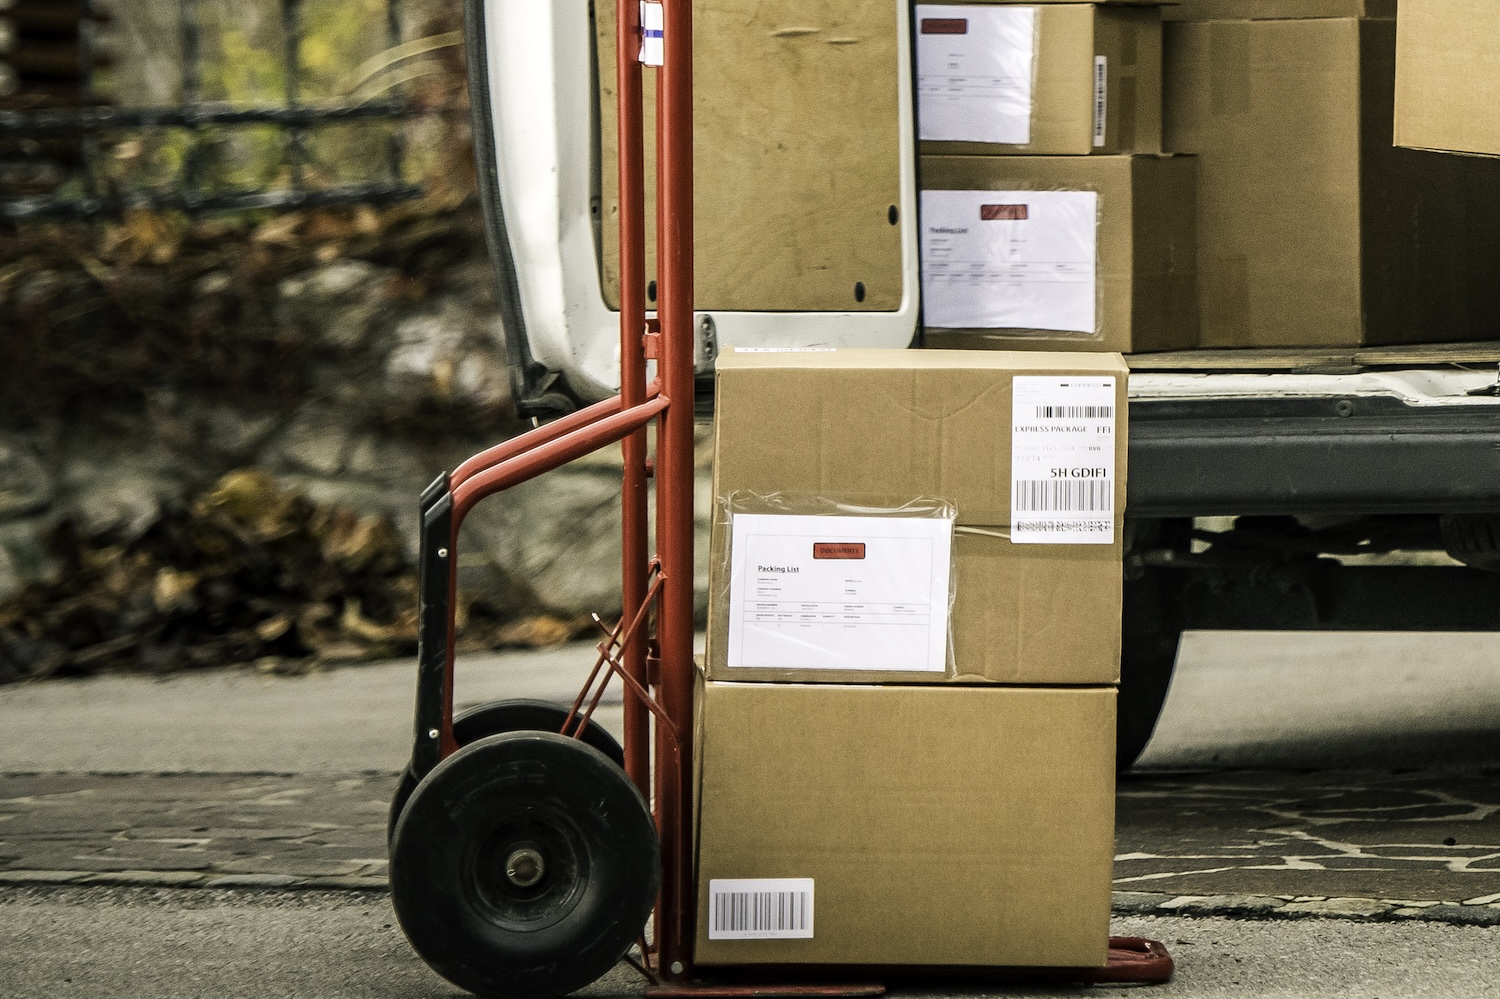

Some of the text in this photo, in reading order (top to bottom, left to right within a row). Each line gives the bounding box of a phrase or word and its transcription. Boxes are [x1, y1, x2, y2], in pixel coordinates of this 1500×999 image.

[1015, 425, 1049, 433] EXPRESS
[1050, 467, 1107, 478] 5H GDIFI
[819, 547, 860, 555] DOCUMENTS
[757, 565, 800, 574] Packing List
